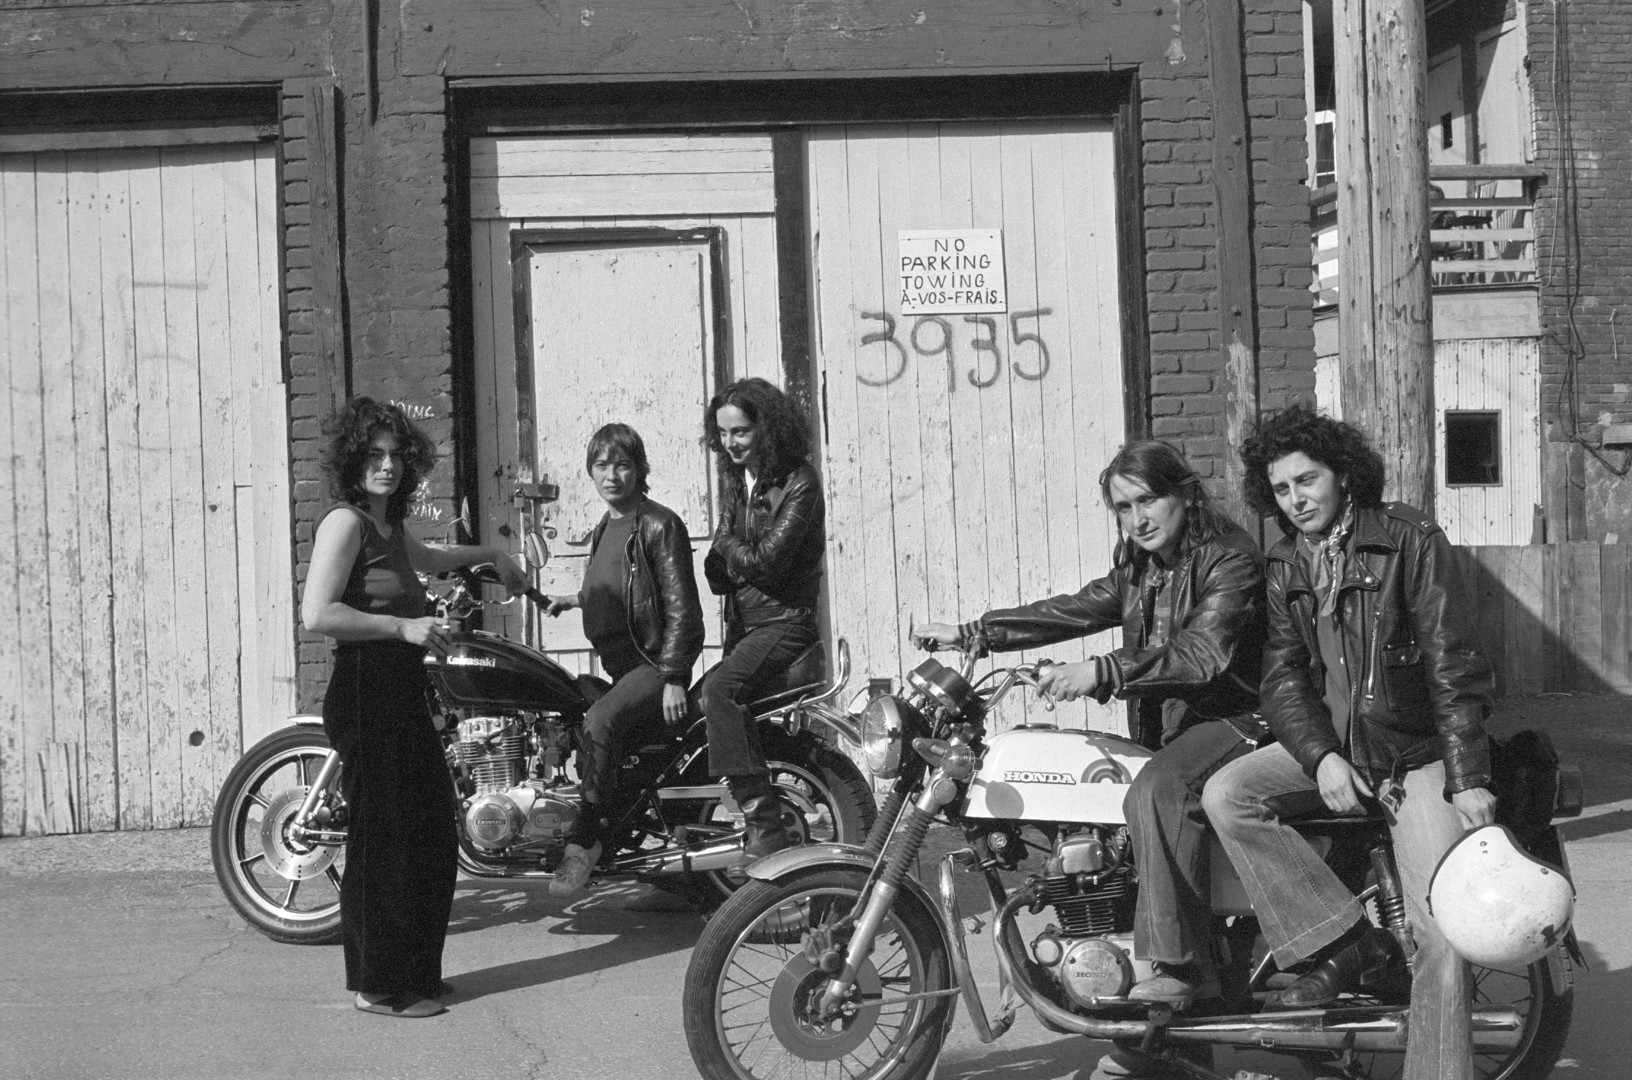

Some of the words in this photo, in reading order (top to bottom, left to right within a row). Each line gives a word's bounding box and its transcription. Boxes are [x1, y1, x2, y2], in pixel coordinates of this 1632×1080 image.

[934, 238, 966, 253] NO
[901, 252, 991, 272] PARKING
[901, 271, 985, 290] TOWING
[856, 307, 1053, 393] 3935
[446, 655, 496, 668] Kawasaki
[1004, 771, 1076, 785] HONDA
[1075, 971, 1115, 979] HONDA
